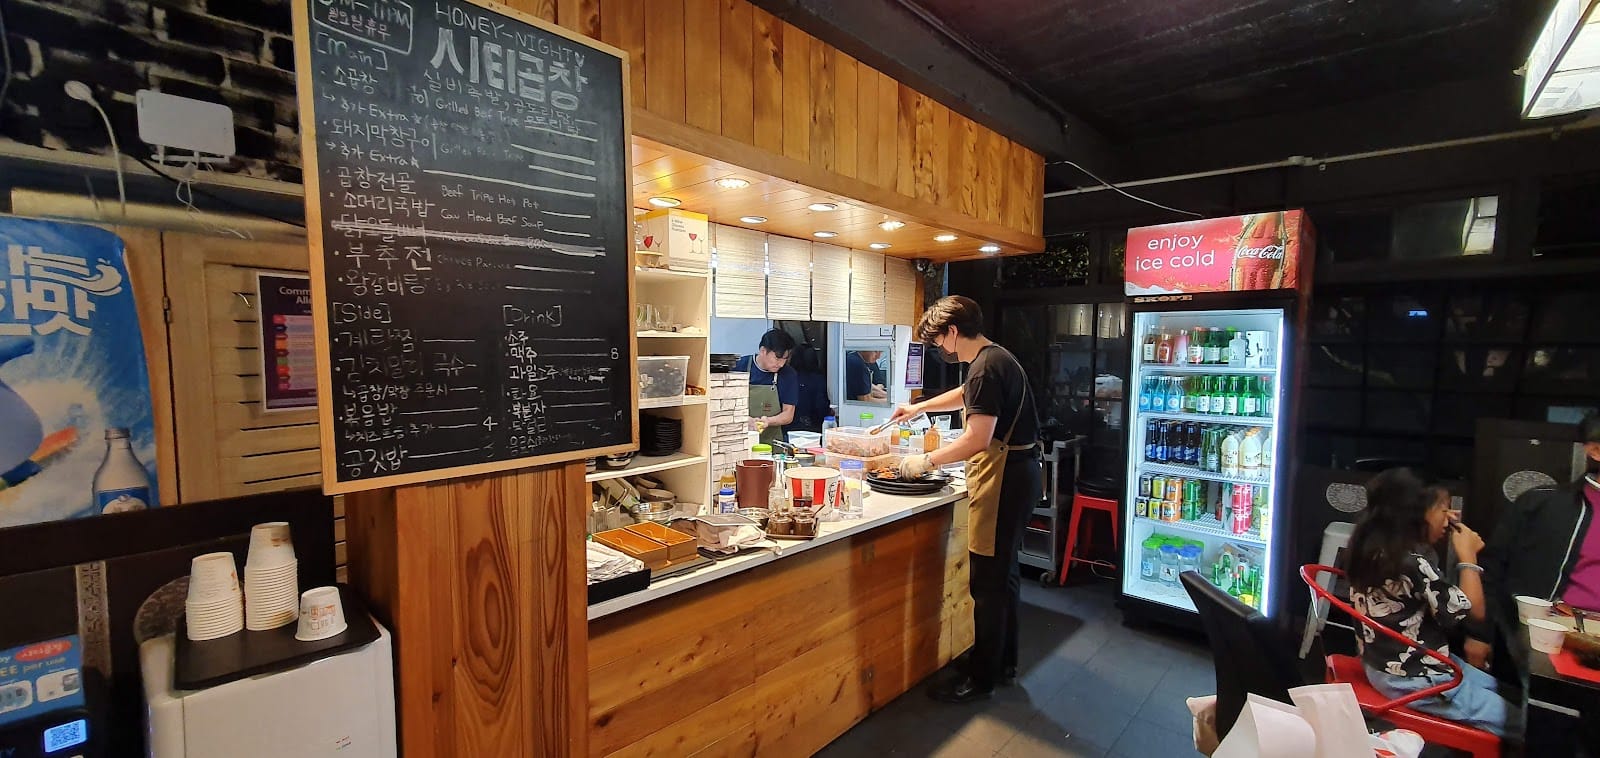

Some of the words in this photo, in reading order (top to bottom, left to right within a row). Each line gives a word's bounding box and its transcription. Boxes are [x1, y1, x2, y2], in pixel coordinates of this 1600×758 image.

[430, 27, 588, 111] 시티곱창
[334, 66, 378, 95] 소곱창
[369, 103, 409, 122] Extra
[369, 150, 408, 166] Extra
[338, 166, 417, 195] 곱창전골
[343, 191, 436, 218] 소머리국밥
[521, 216, 544, 229] Soup
[1147, 234, 1204, 251] enjoy
[1236, 244, 1284, 260] Coca-Cola
[1134, 256, 1164, 273] ice
[1169, 250, 1215, 268] cold
[332, 302, 392, 324] [Side]
[508, 330, 529, 347] 소주
[510, 346, 538, 364] 맥주
[482, 416, 499, 432] 4
